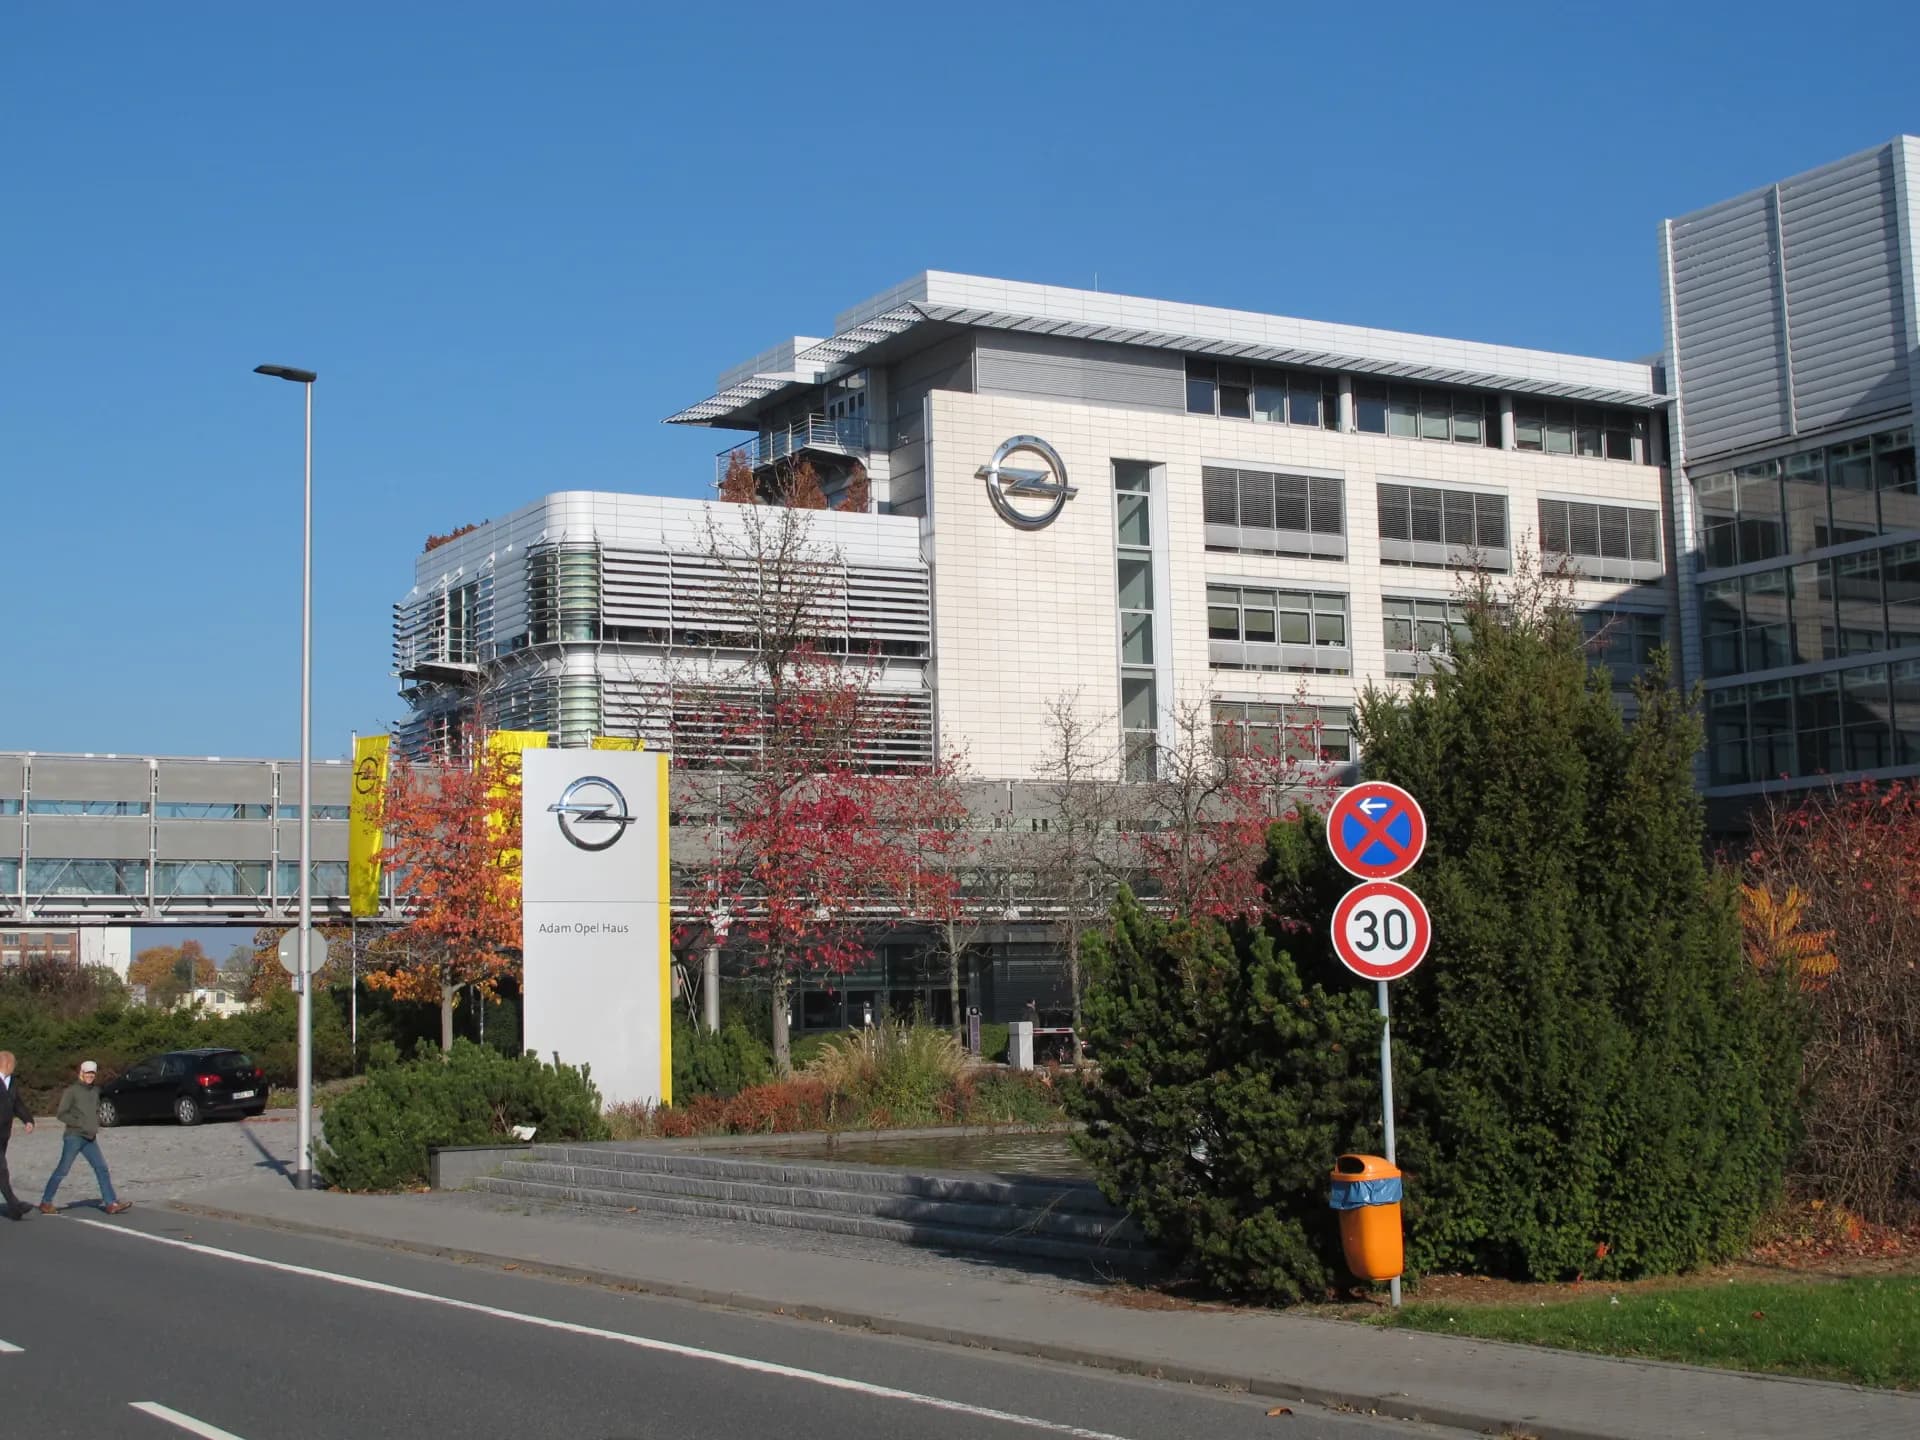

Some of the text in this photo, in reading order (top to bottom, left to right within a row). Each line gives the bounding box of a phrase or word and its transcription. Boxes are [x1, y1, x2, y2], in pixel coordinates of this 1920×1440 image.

[539, 923, 629, 936] Adam Opel Haus
[1354, 909, 1408, 952] 30
